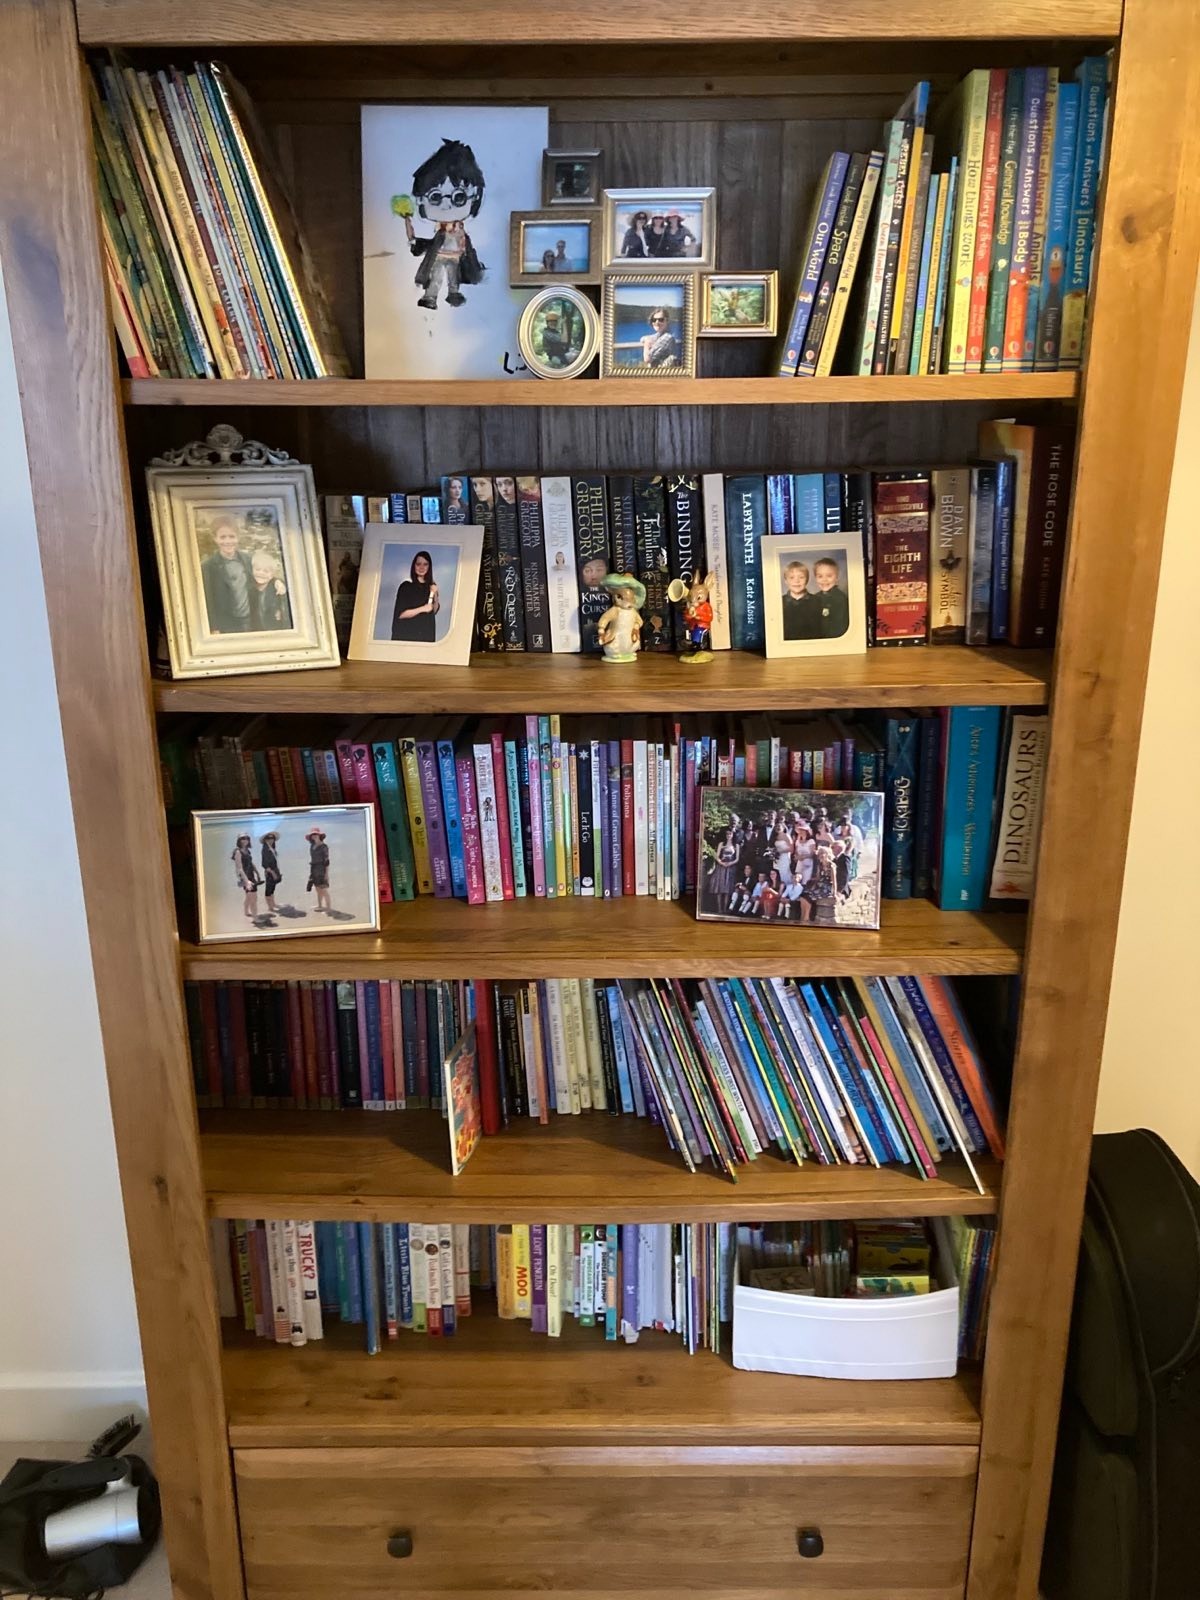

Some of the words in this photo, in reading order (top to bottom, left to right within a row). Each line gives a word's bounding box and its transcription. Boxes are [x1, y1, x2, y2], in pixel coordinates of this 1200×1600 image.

[1026, 97, 1040, 153] Questions
[1040, 100, 1054, 156] Questions
[1085, 85, 1100, 142] Questions
[966, 159, 980, 188] How
[1001, 159, 1017, 196] General
[1079, 158, 1093, 206] Answers
[843, 184, 856, 204] Look
[856, 193, 871, 219] bees?
[1020, 168, 1034, 215] Answers
[1034, 170, 1048, 218] Answers
[1051, 172, 1069, 231] Numbers
[963, 190, 976, 229] things
[996, 198, 1013, 245] Knowledge
[813, 220, 829, 247] Our
[850, 239, 859, 251] we
[851, 219, 864, 240] need
[1013, 230, 1029, 263] Body
[805, 245, 824, 281] World
[826, 228, 847, 266] Space
[844, 252, 855, 262] do
[960, 232, 974, 267] work
[1028, 231, 1044, 281] Animals
[1072, 217, 1087, 284] Dinosaurs
[841, 262, 854, 280] Why
[904, 272, 915, 303] SCIENCE
[879, 309, 888, 344] HAMILTON
[1048, 444, 1060, 469] THE
[1046, 472, 1058, 506] ROSE
[519, 500, 532, 547] GREGORY
[528, 500, 541, 548] PHILIPPA
[576, 480, 593, 558] GREGORY
[588, 485, 603, 554] PHILIPPA
[622, 495, 632, 529] SUITE
[741, 492, 754, 564] LABYRINTH
[937, 494, 954, 548] BROWN
[951, 505, 965, 534] DAN
[1042, 509, 1055, 547] CODE
[641, 511, 662, 568] Familiars
[652, 530, 660, 543] The
[676, 500, 695, 584] BINDING
[711, 525, 719, 550] MOSSE
[894, 544, 908, 552] THE
[884, 552, 922, 564] EIGHTH
[891, 564, 912, 574] LIFE
[523, 567, 534, 612] DAUGHTER
[529, 561, 542, 618] KINGMAKER'S
[581, 592, 610, 602] KING'S
[647, 584, 656, 610] HALLS
[745, 577, 755, 598] Kate
[938, 571, 951, 613] SYMBOL
[746, 600, 756, 624] Mosse
[861, 765, 874, 788] BAD
[965, 759, 981, 811] Adventures
[610, 788, 618, 807] Anne
[611, 809, 619, 818] of
[623, 784, 631, 818] Pollyanna
[892, 775, 910, 832] ICKABOG
[1003, 729, 1038, 864] DINOSAURS
[580, 811, 589, 823] Let
[611, 819, 619, 841] Green
[581, 831, 589, 842] Go
[961, 822, 976, 875] Wonderland
[612, 843, 620, 869] Gables
[722, 990, 736, 1018] BEDTIME
[732, 1017, 744, 1042] STORIES
[712, 1041, 730, 1075] HENRIETTA'S
[725, 1074, 736, 1091] FIRST
[731, 1090, 744, 1112] WINTER
[299, 1232, 315, 1279] TRUCK?
[399, 1238, 409, 1263] Little
[400, 1265, 410, 1284] Blue
[442, 1268, 452, 1298] Cookbook
[515, 1266, 528, 1296] MOO
[533, 1258, 544, 1290] PENGUIN
[549, 1264, 557, 1275] Oh
[549, 1277, 557, 1297] Dear!
